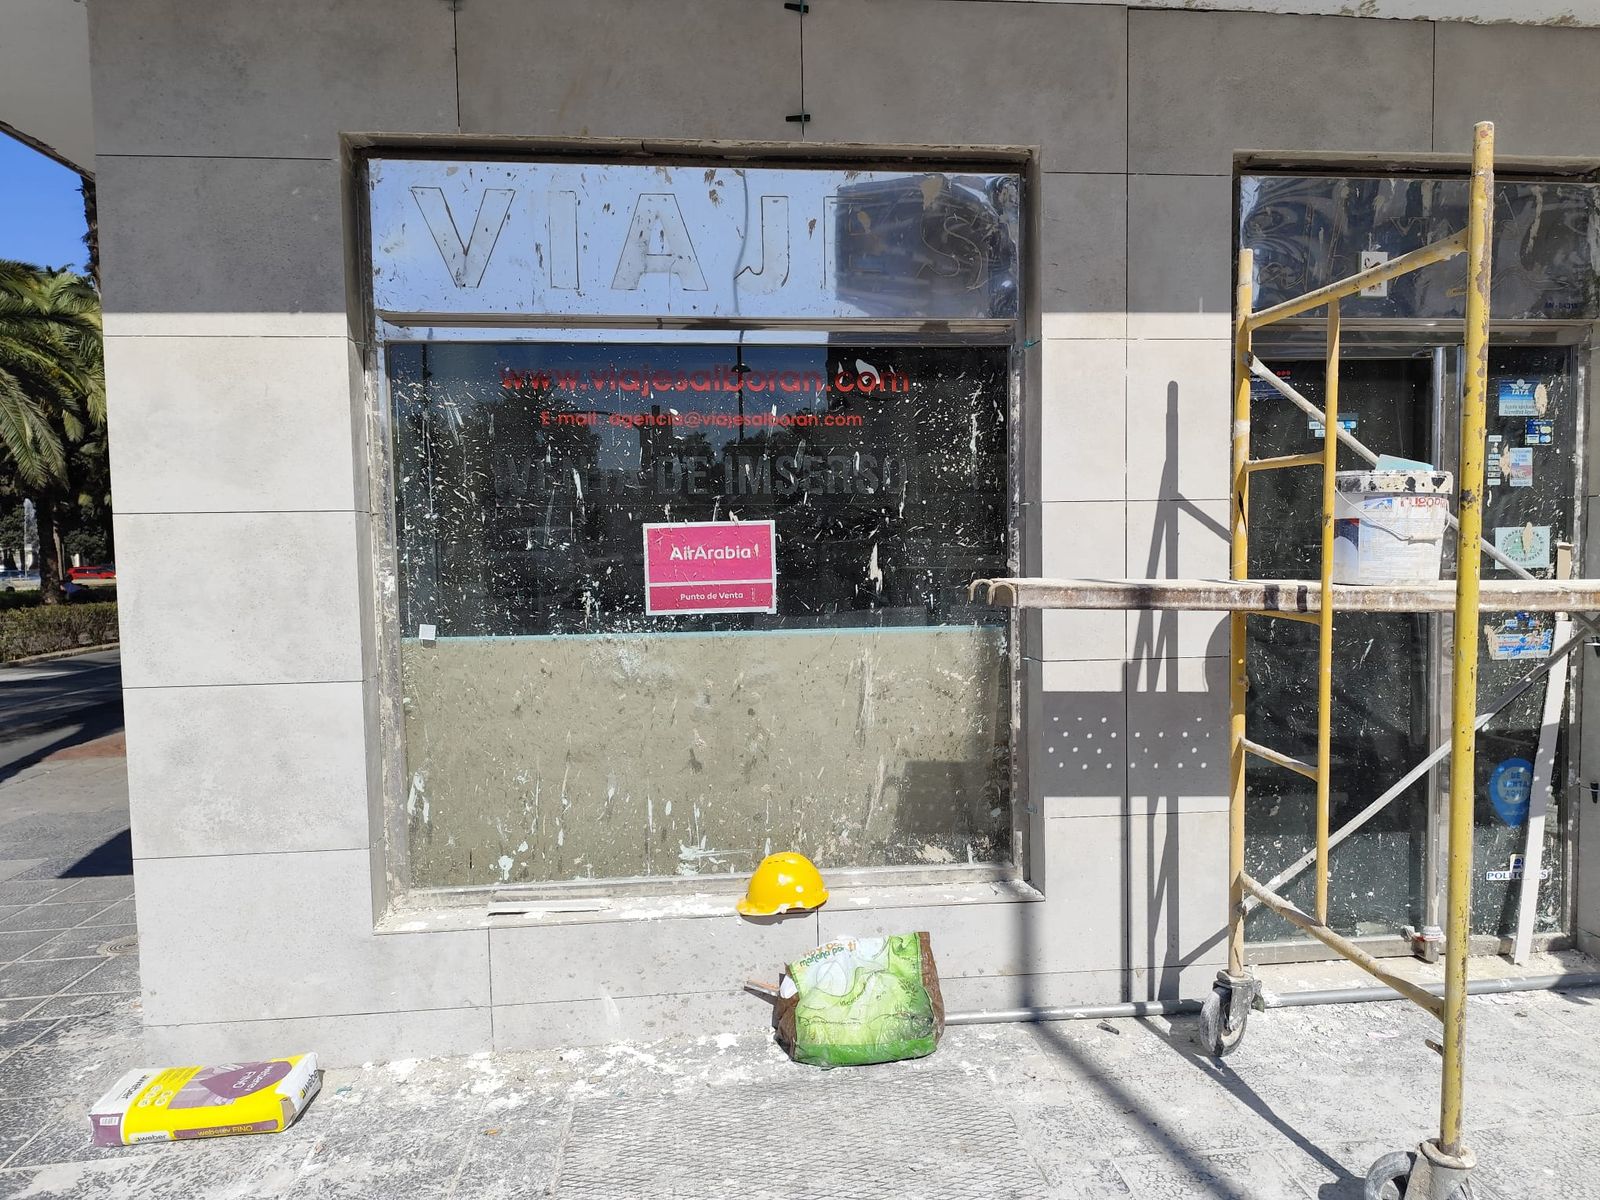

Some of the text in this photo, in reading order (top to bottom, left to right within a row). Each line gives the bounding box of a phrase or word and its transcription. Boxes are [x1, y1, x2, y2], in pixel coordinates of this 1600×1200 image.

[501, 363, 910, 397] www.viajesalboran.com
[608, 411, 863, 428] agencia@viajesalboran.com
[656, 456, 708, 496] DE
[680, 591, 744, 601] Punto de Venta
[232, 1124, 253, 1134] FINO
[139, 1133, 167, 1142] weber
